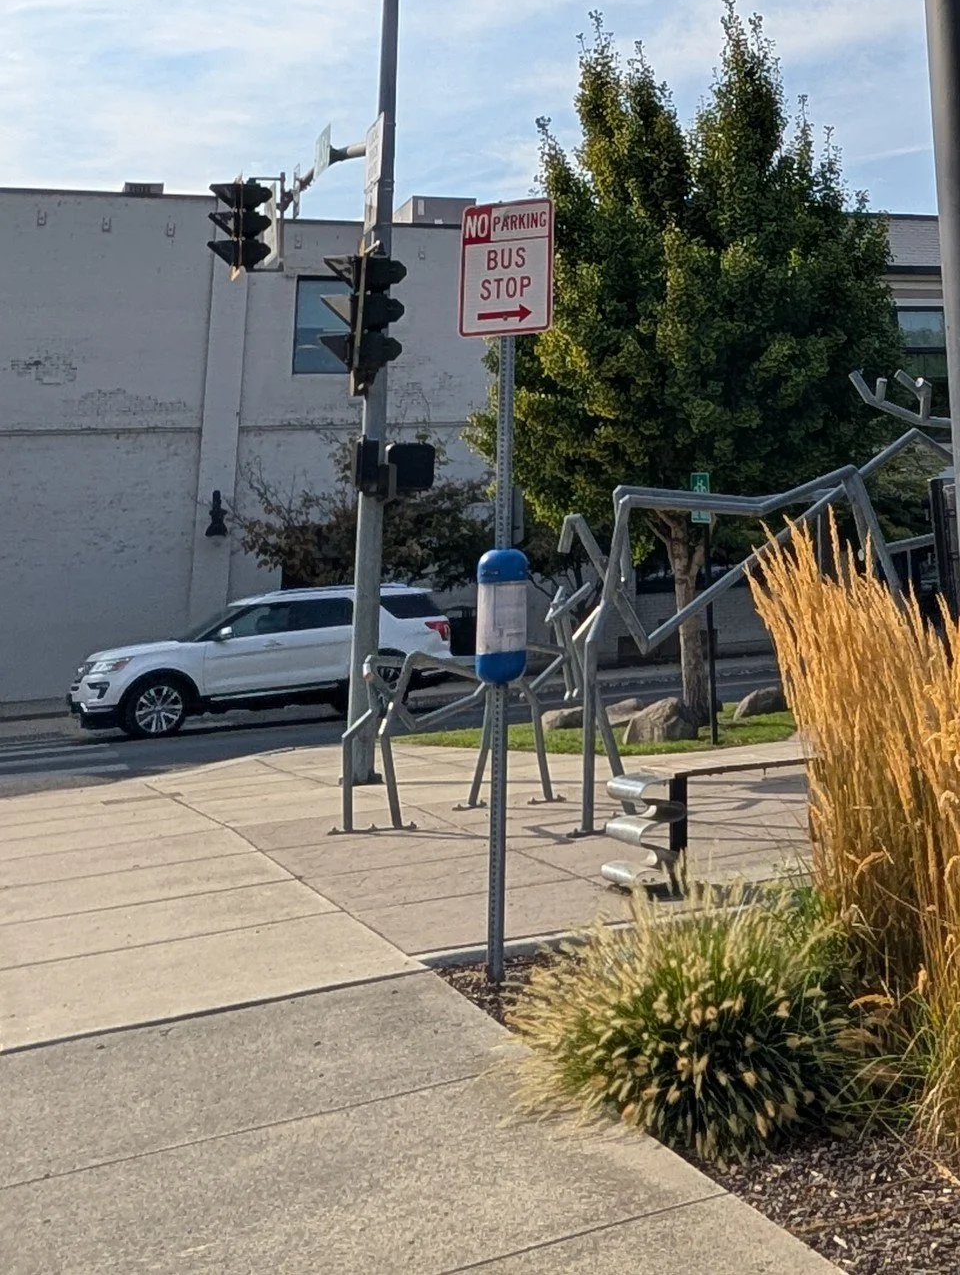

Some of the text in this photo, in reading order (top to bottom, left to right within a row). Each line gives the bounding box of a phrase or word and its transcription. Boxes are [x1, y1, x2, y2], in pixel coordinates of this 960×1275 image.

[464, 210, 547, 239] NO PARKING
[486, 246, 527, 271] BUS
[480, 275, 531, 301] STOP
